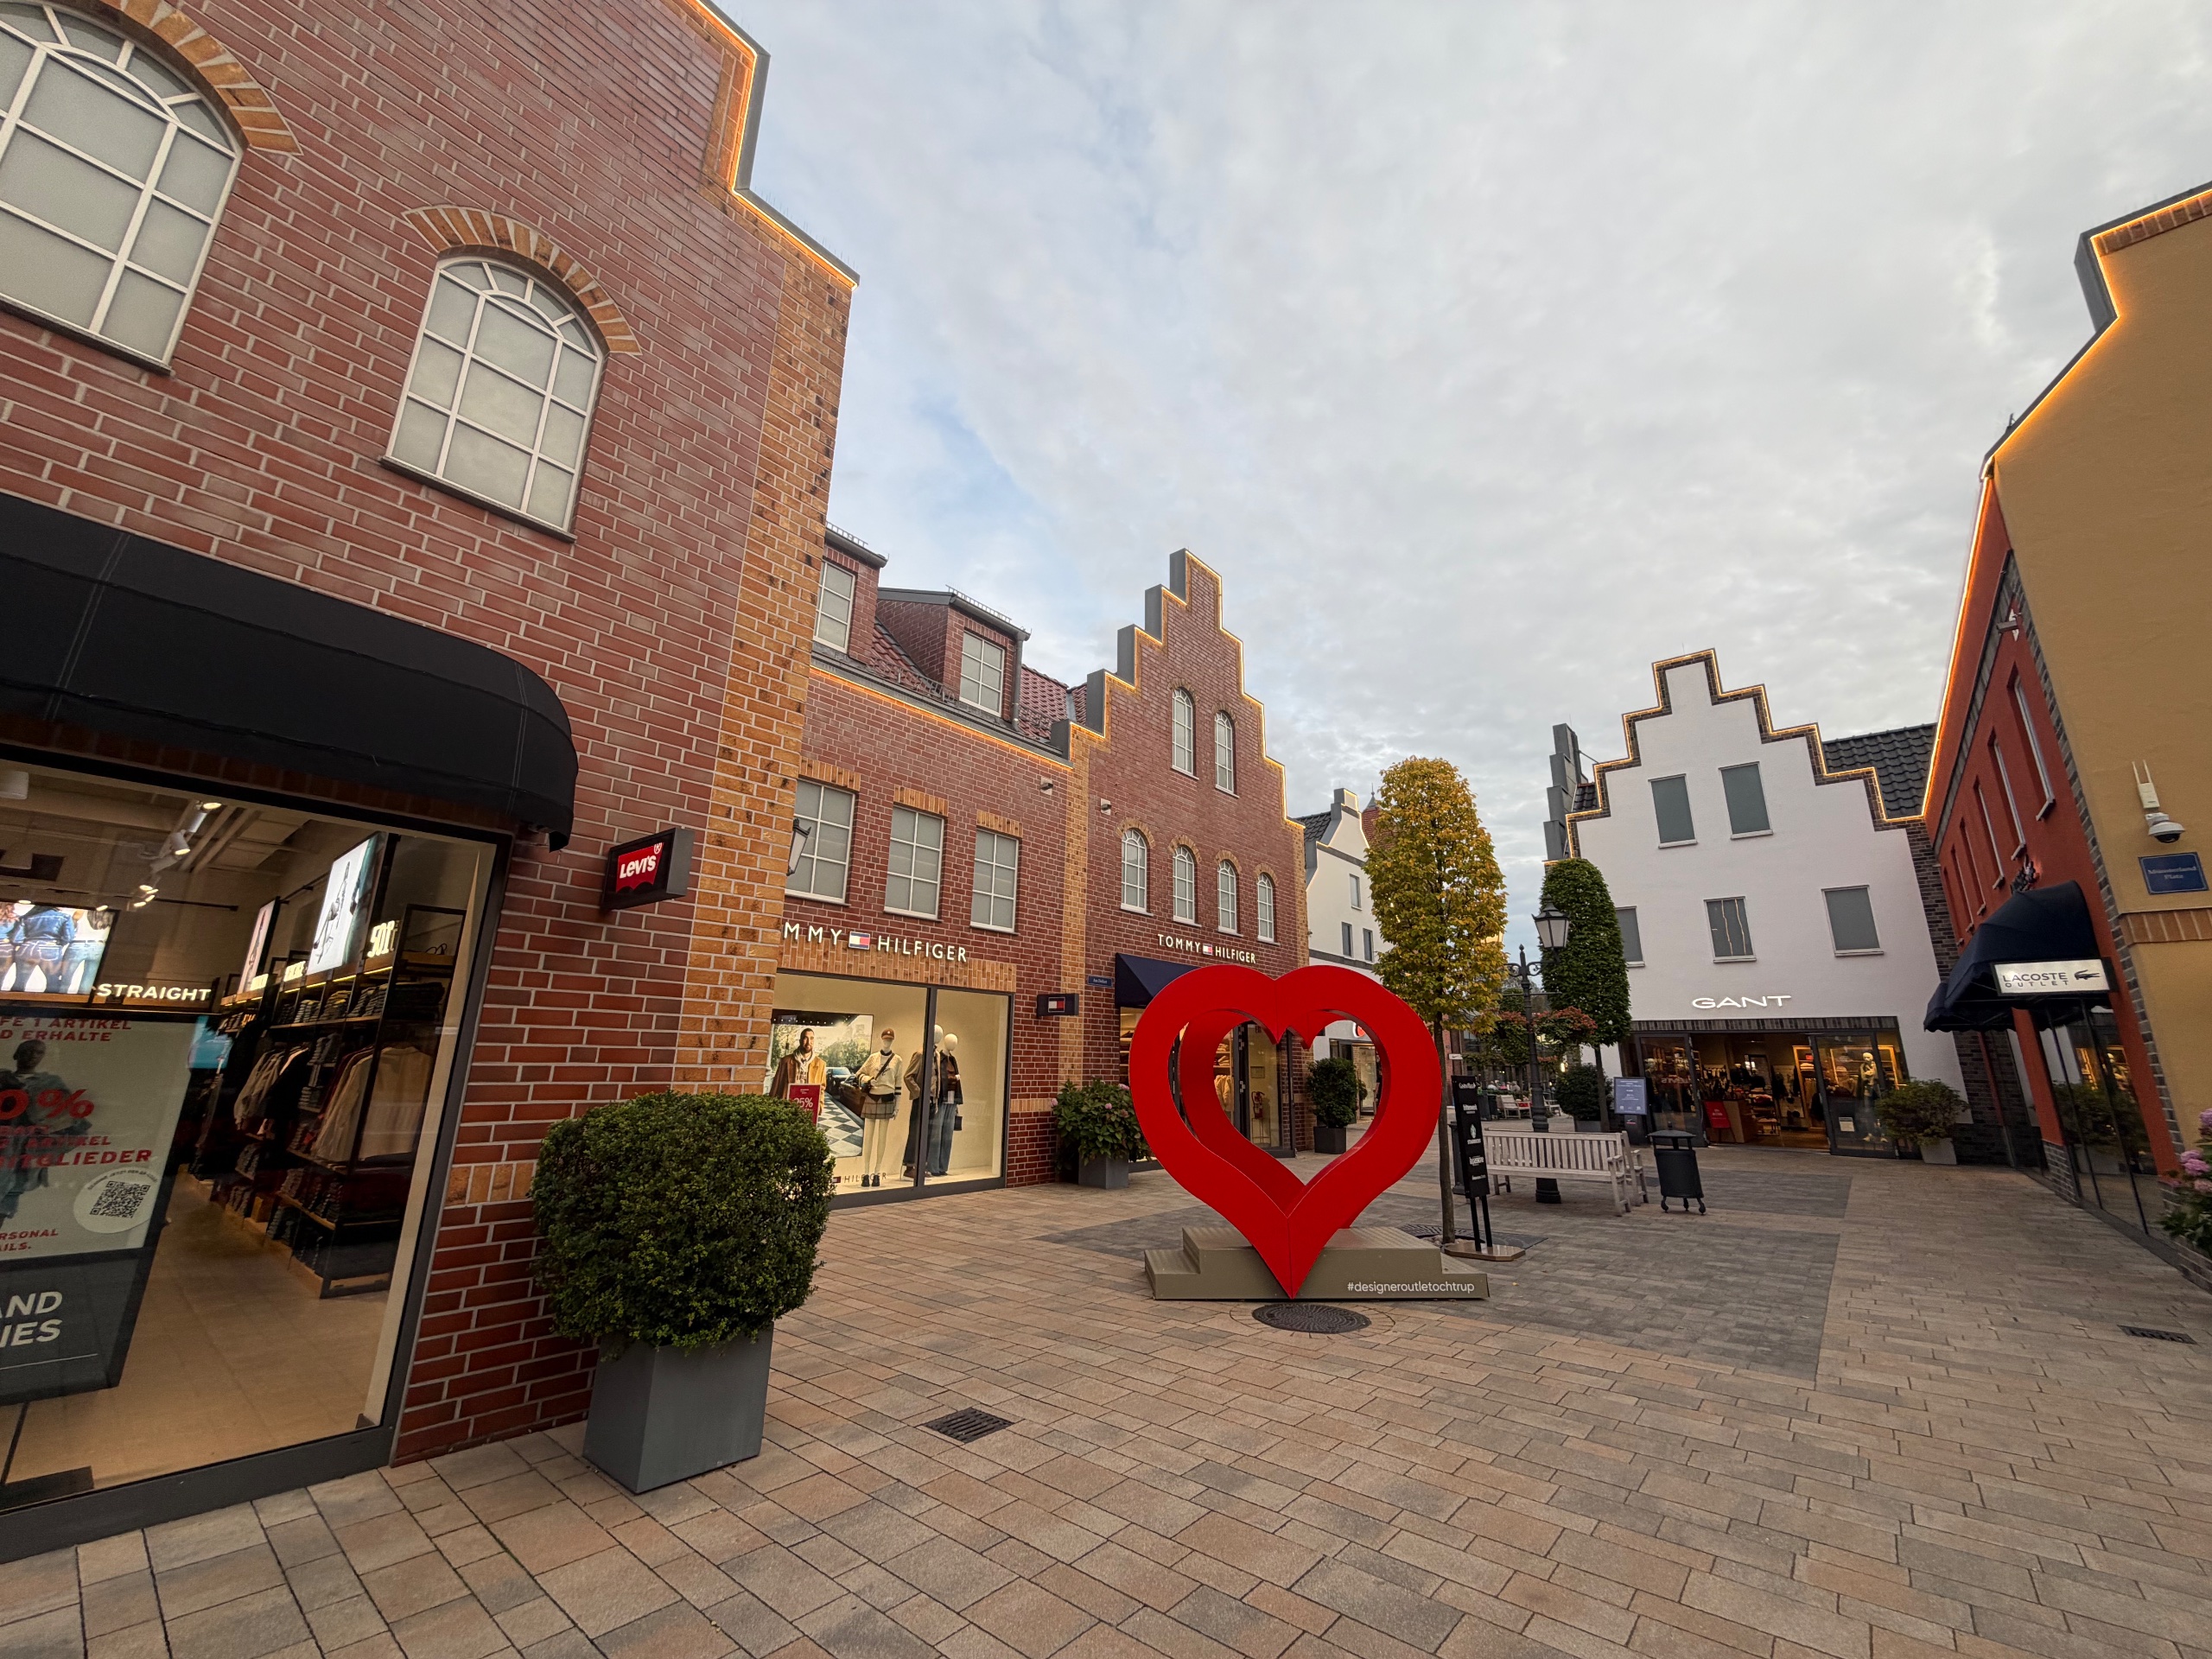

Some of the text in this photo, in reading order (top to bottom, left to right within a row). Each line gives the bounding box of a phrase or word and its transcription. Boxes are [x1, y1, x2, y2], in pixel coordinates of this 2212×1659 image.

[877, 935, 967, 962] HILFIGER
[1157, 933, 1256, 963] TOMMY HILFIGER
[2002, 972, 2068, 982] LACOSTE
[96, 983, 212, 1001] STRAIGHT
[1692, 995, 1791, 1009] GANT
[48, 1018, 132, 1030] ARTIKEL
[22, 1030, 112, 1042] ERHALTE
[1347, 1281, 1475, 1294] #designeroutletochtrup
[0, 1291, 63, 1319] ND
